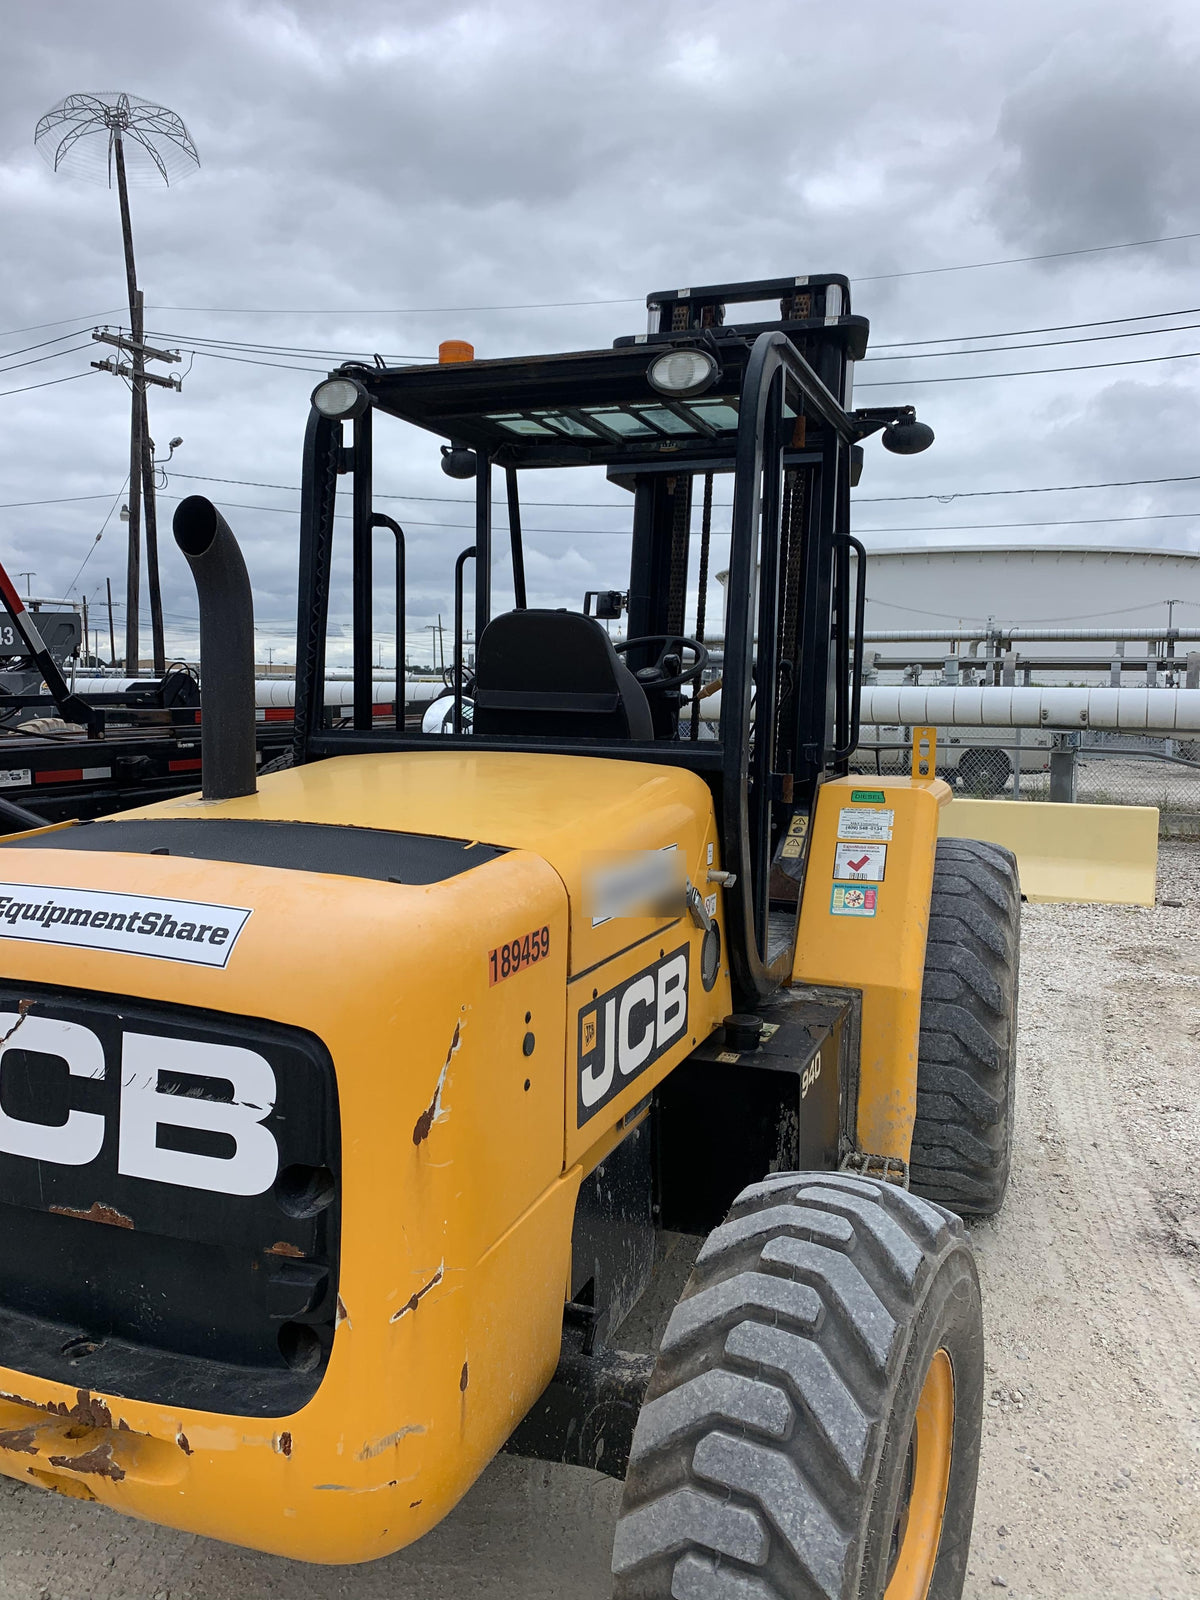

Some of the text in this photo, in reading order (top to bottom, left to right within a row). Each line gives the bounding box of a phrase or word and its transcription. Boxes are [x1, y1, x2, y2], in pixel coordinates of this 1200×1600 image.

[0, 896, 230, 946] EquipmentShare
[490, 925, 550, 982] 189459
[581, 953, 687, 1108] JCB
[801, 1050, 821, 1099] 940
